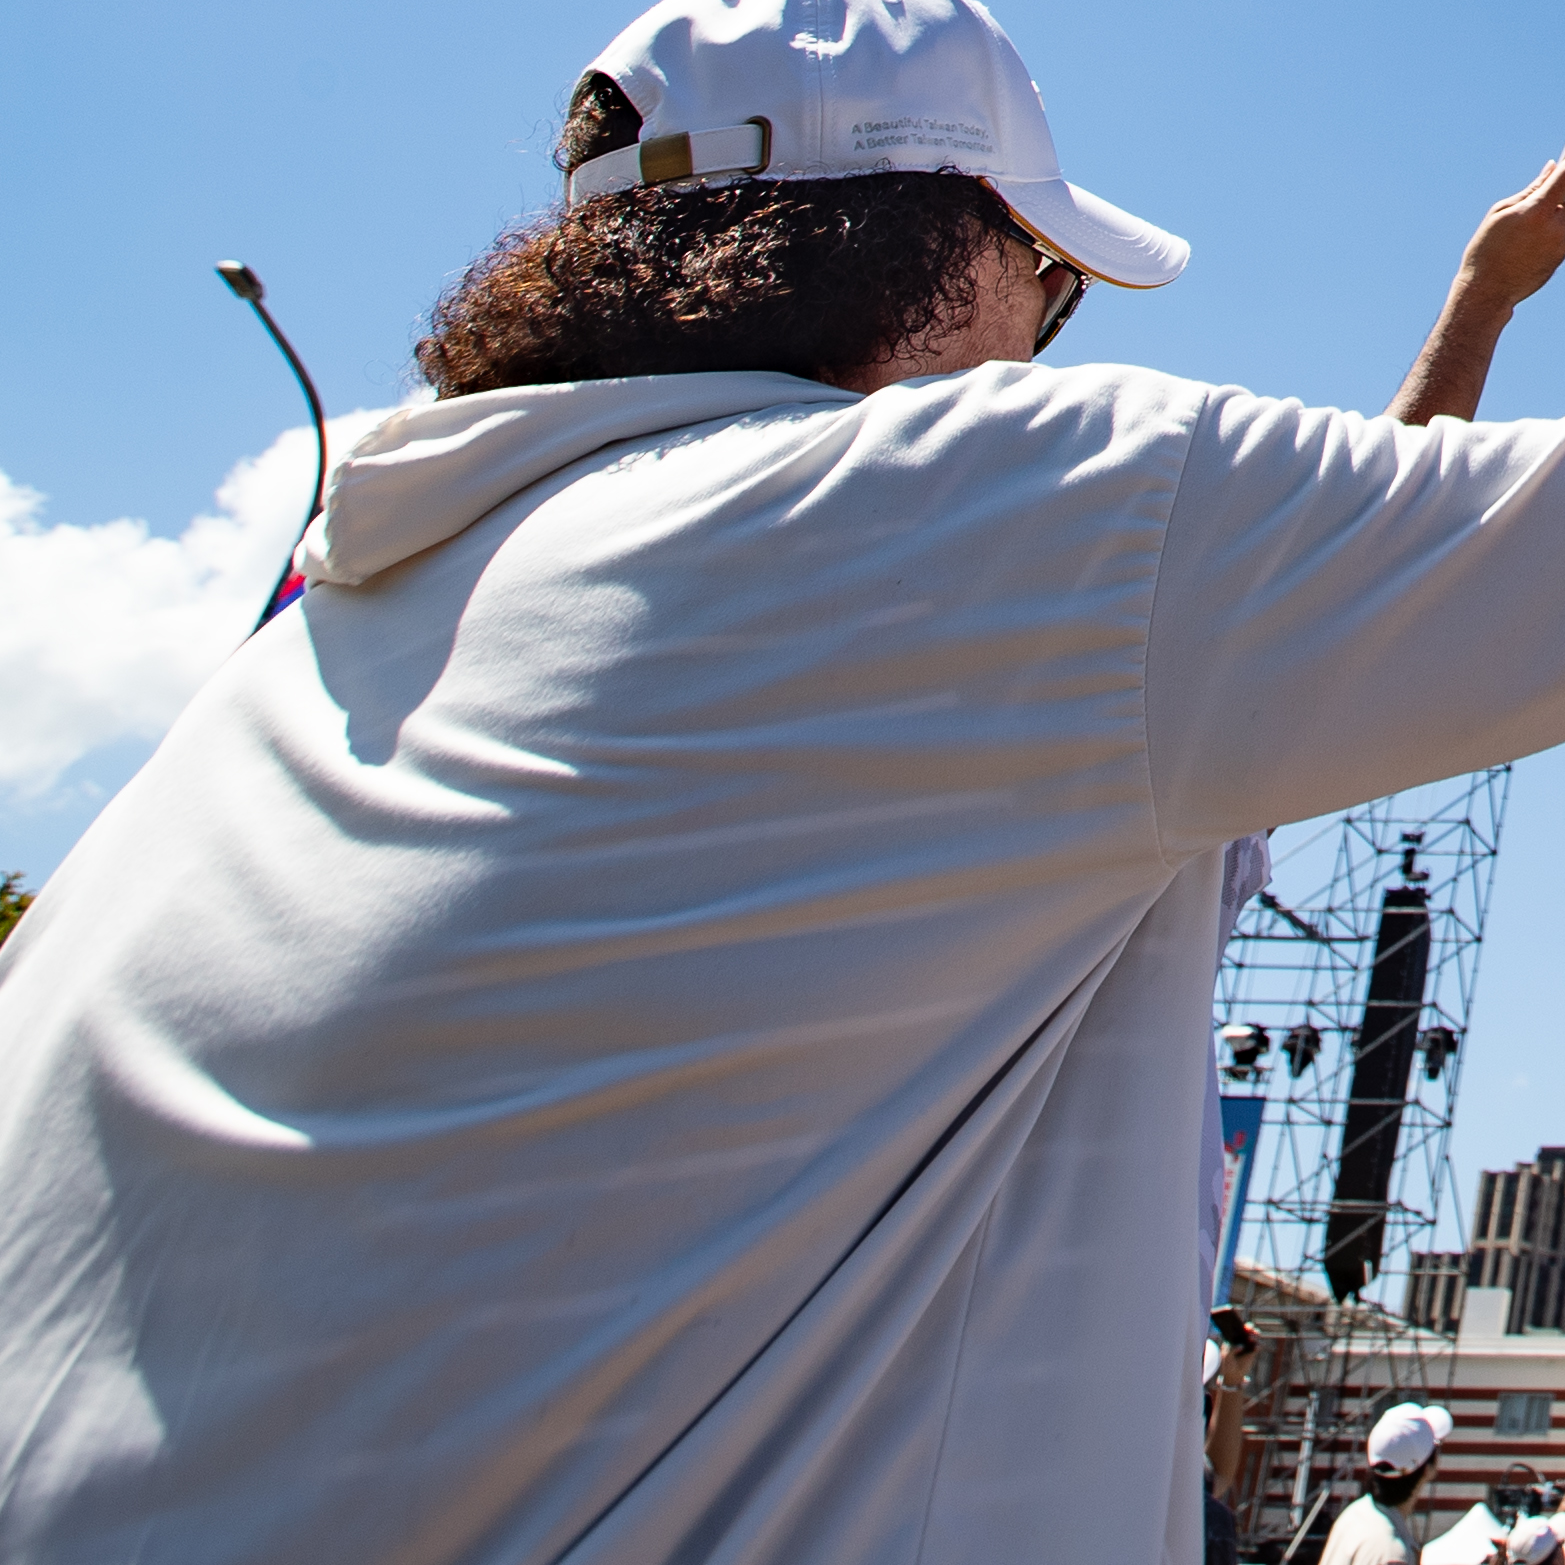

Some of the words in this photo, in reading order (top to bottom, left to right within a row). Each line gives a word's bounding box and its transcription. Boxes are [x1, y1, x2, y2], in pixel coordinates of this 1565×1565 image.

[851, 123, 862, 135] A
[864, 117, 922, 134] Beautiful
[923, 119, 956, 132] Taiwan
[958, 122, 989, 139] Today,
[854, 140, 865, 152] A
[867, 135, 909, 149] Better
[910, 133, 946, 147] Taiwan
